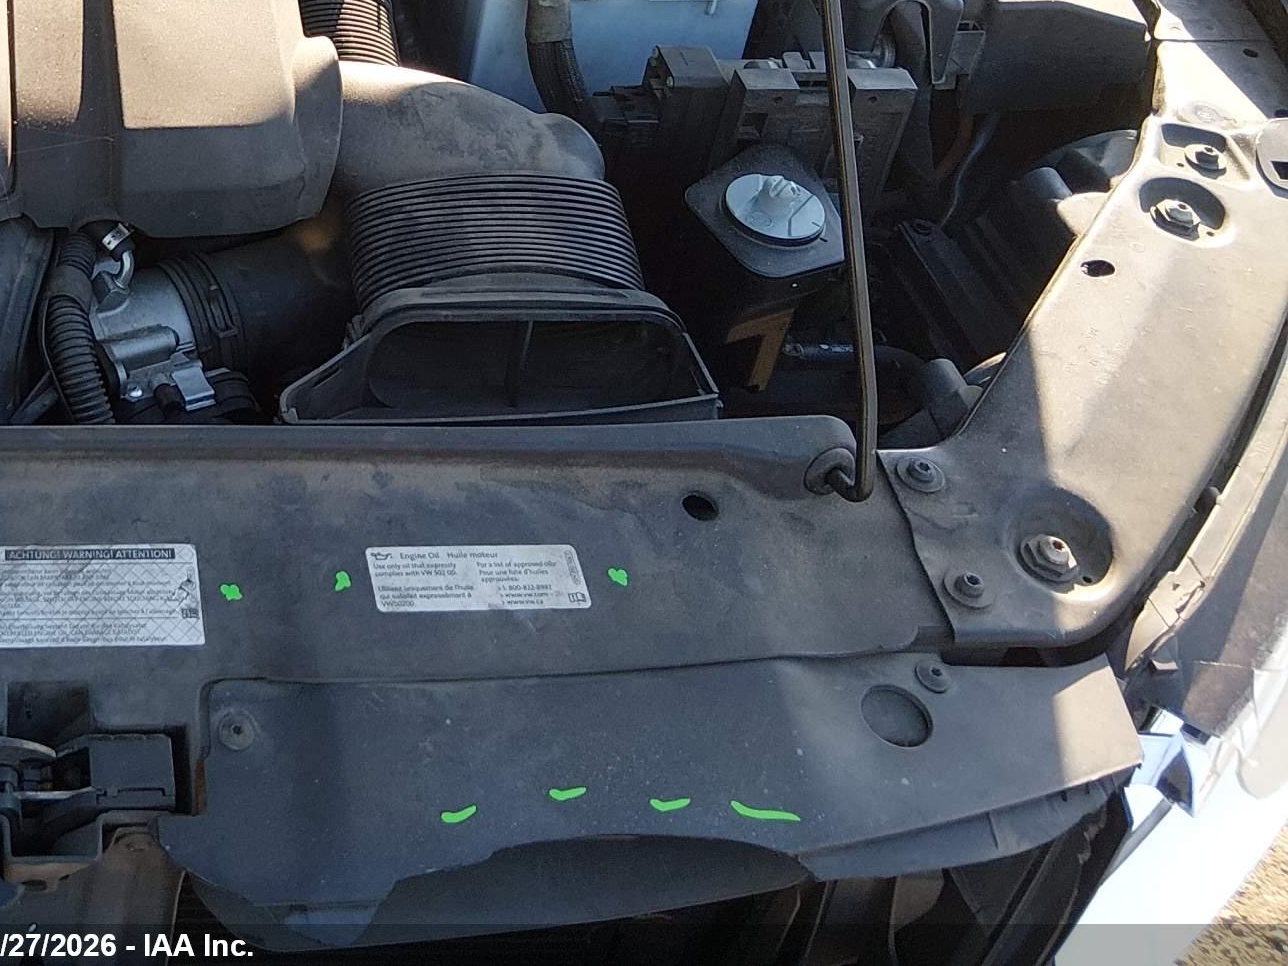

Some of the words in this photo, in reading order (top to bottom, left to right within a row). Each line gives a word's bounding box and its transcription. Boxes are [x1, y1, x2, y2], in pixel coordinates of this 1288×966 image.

[9, 550, 61, 559] ACHTUNG!
[62, 549, 113, 559] WARNING!
[115, 549, 171, 558] ATTENTION!
[400, 552, 427, 561] Engine
